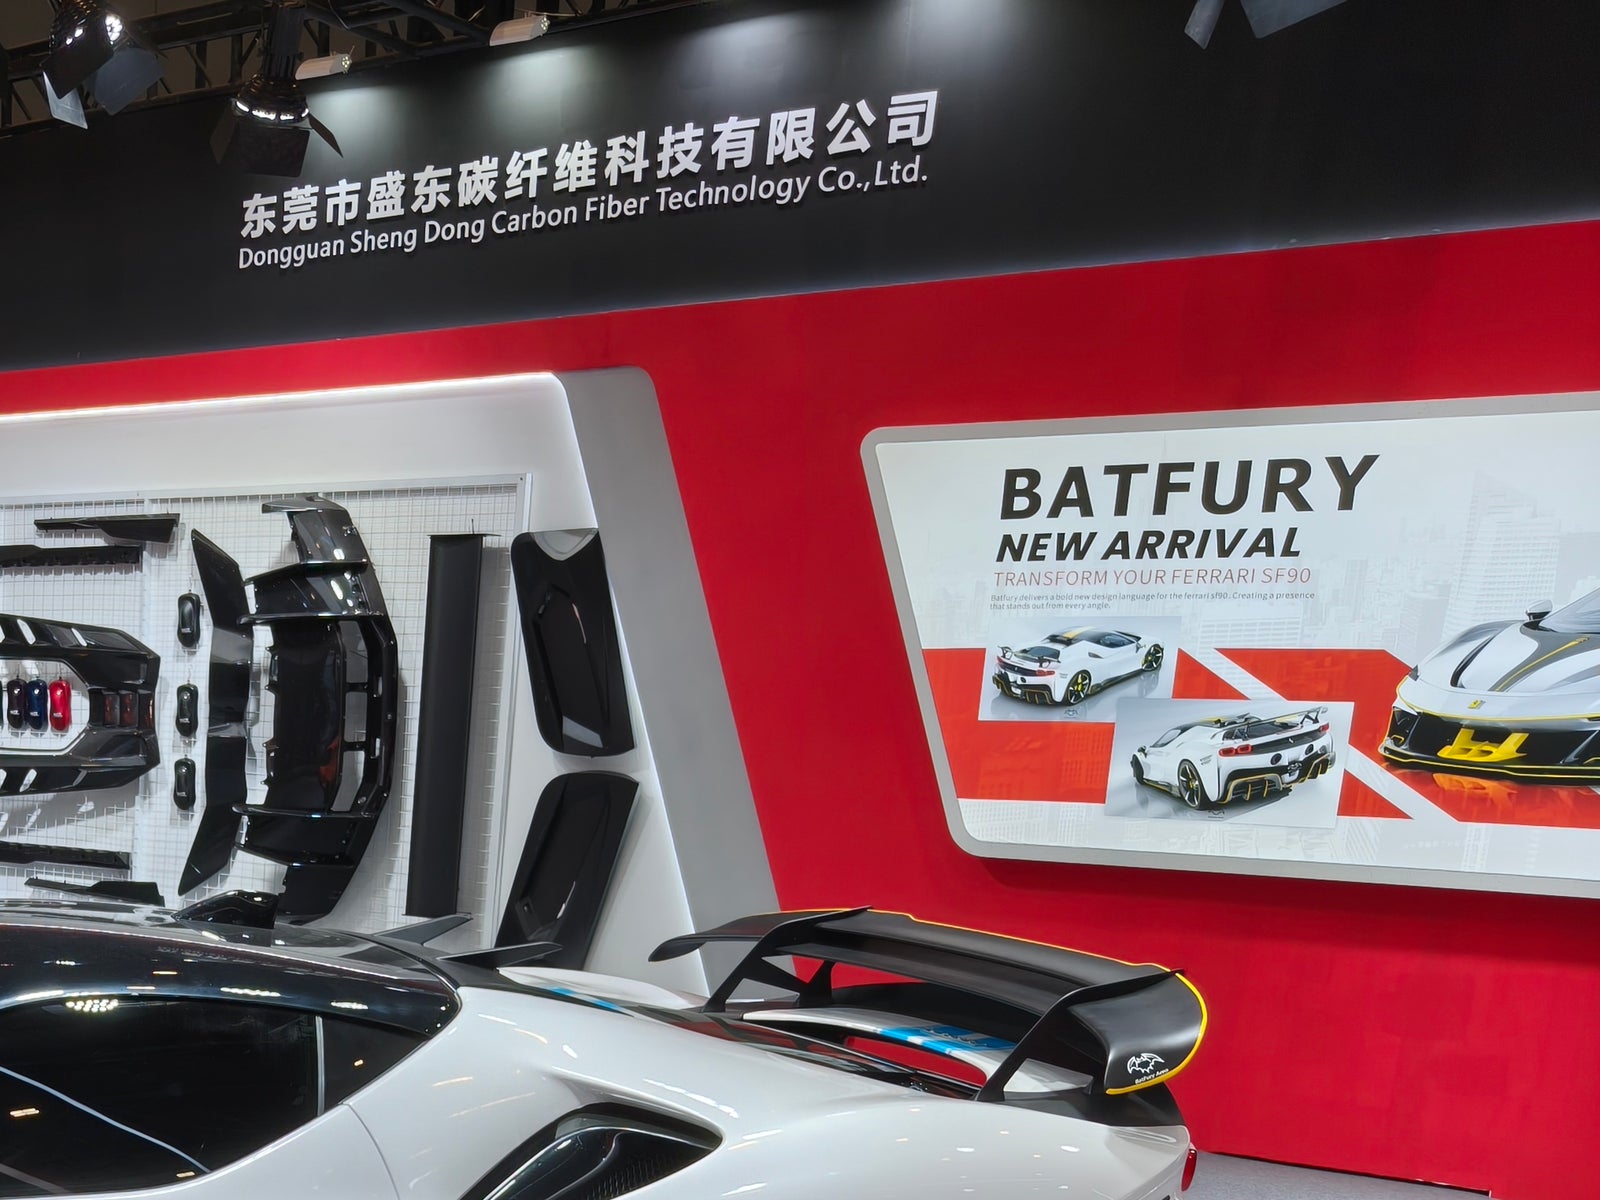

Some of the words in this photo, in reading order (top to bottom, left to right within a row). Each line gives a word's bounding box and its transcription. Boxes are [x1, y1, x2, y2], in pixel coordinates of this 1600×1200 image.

[240, 90, 940, 239] 东莞市盛东碳纤维科技有限公司
[238, 233, 345, 269] Dongguan
[350, 224, 418, 254] Sheng
[423, 216, 485, 246] Dong
[491, 202, 578, 235] Carbon
[585, 191, 651, 222] Fiber
[656, 173, 810, 216] Technology
[1000, 454, 1380, 520] BATFURY
[996, 532, 1098, 562] NEW
[1101, 527, 1300, 560] ARRIVAL
[994, 570, 1108, 587] TRANSFORM
[1113, 569, 1166, 585] YOUR
[1171, 568, 1255, 585] FERRARI
[1262, 567, 1311, 584] SF90
[990, 602, 1004, 610] that
[1006, 602, 1029, 610] stands
[1031, 602, 1044, 610] out
[1065, 603, 1085, 611] every
[1019, 593, 1049, 601] delivers
[1056, 593, 1073, 601] bold
[1092, 593, 1117, 602] design
[1118, 592, 1155, 602] language
[1156, 592, 1168, 600] for
[1169, 592, 1182, 600] the
[1232, 591, 1267, 601] Creating
[1276, 593, 1315, 601] presence
